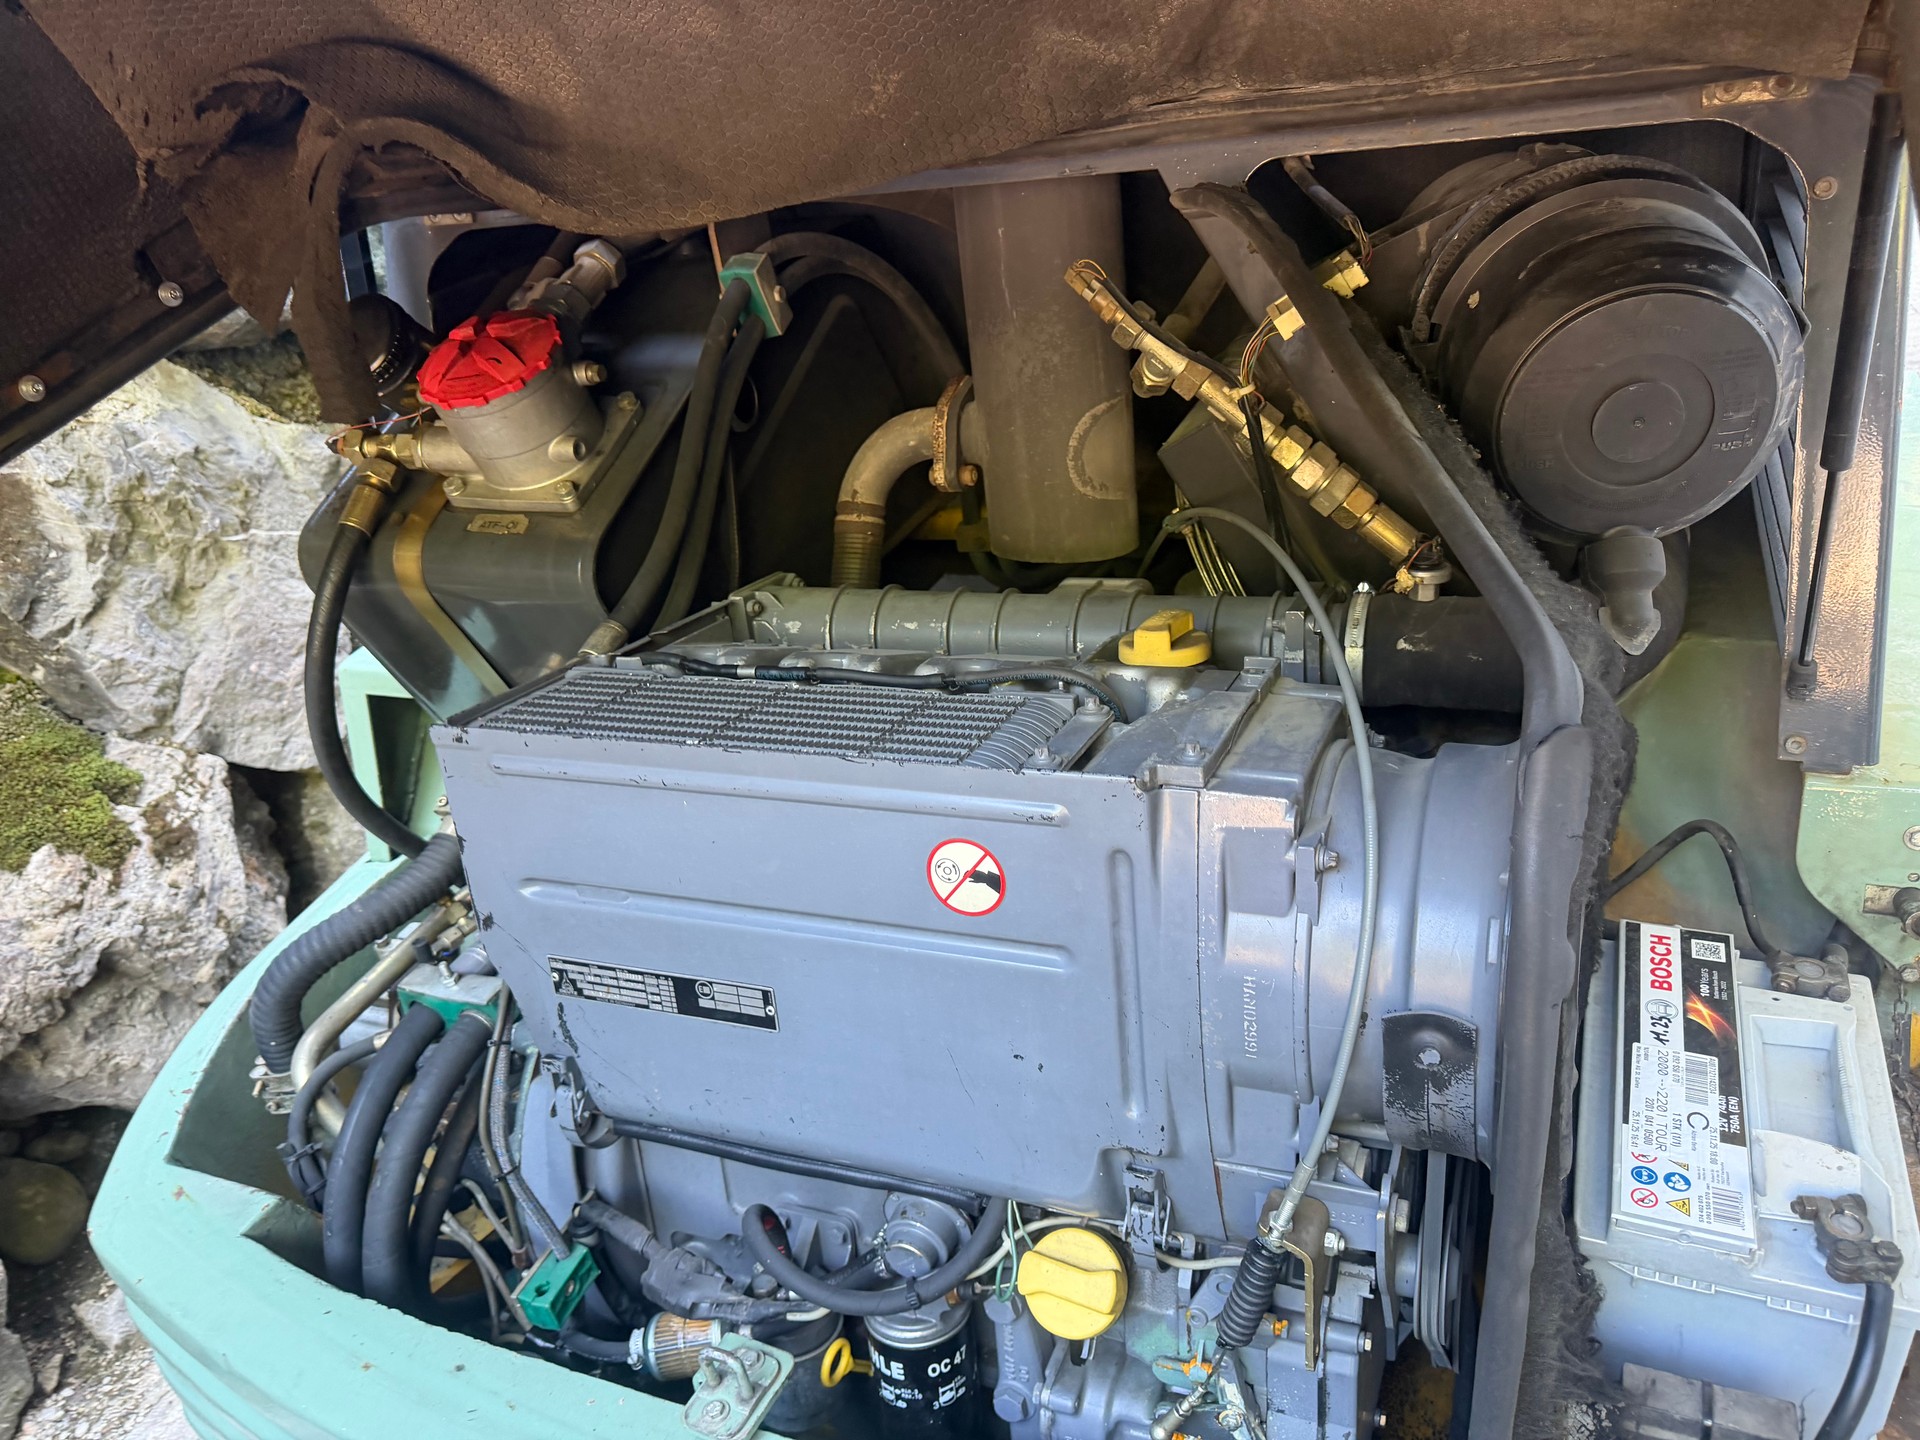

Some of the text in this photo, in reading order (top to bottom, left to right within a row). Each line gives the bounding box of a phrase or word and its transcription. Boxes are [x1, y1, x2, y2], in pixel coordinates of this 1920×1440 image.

[1650, 934, 1672, 991] BOSCH
[1700, 983, 1709, 997] 100
[1657, 1050, 1669, 1076] 2000
[1632, 1110, 1640, 1132] 25.11.25
[1672, 1118, 1682, 1130] STK
[1718, 1114, 1728, 1133] 12V
[1728, 1096, 1740, 1134] 750A (EN)
[1655, 1123, 1668, 1152] TOUR
[1670, 1132, 1682, 1148] (1/1)
[1710, 1126, 1718, 1150] 25.11.25
[928, 1344, 966, 1378] OC 47
[932, 1400, 940, 1410] 3
